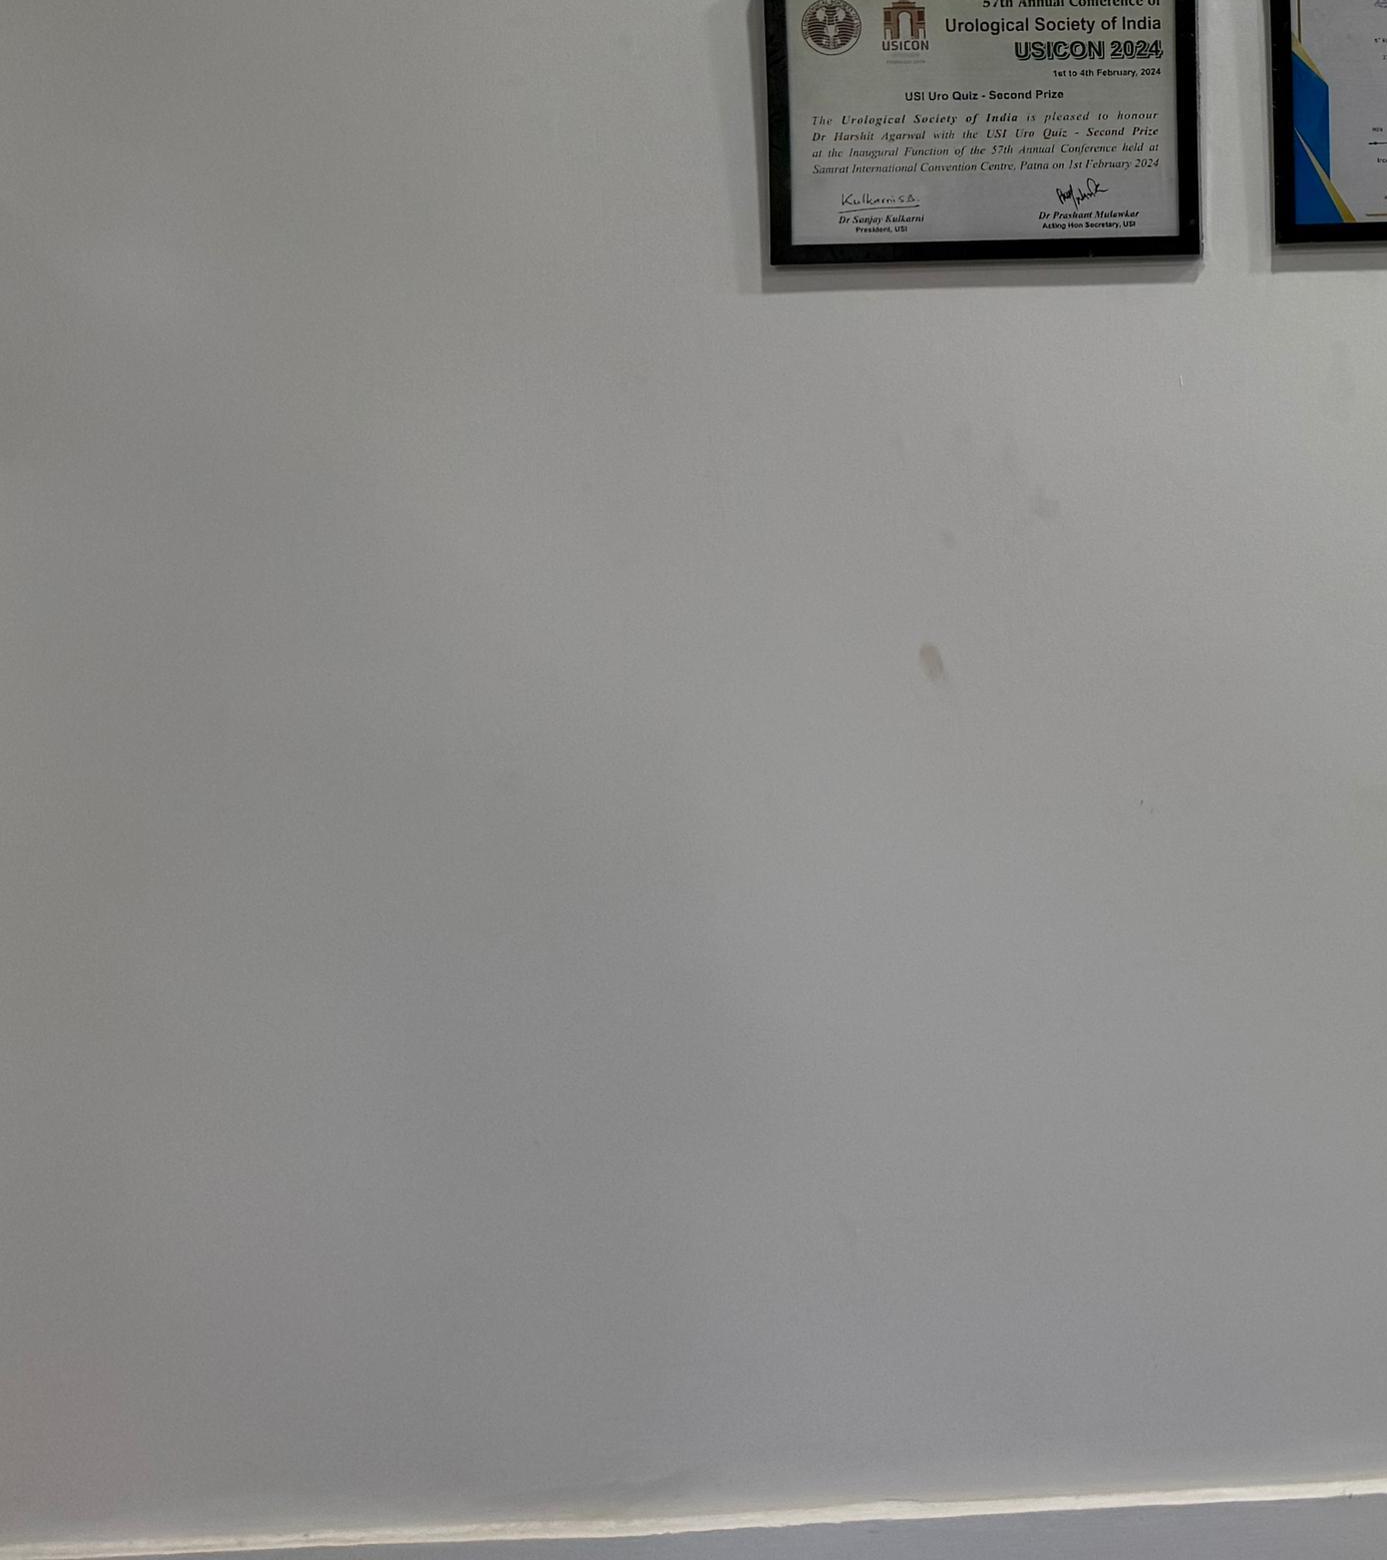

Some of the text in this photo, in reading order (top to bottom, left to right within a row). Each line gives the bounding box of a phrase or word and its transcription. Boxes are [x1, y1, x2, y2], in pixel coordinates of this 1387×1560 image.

[945, 16, 1161, 35] Urological Society of India
[882, 40, 929, 51] USICON
[1015, 40, 1164, 61] USICON 2024
[905, 91, 925, 101] USI
[928, 91, 949, 101] Uro
[952, 91, 978, 101] Quiz
[989, 90, 1032, 100] Second
[1036, 90, 1064, 99] Prize
[812, 110, 1158, 127] The Urological Society of India is pleased to honour
